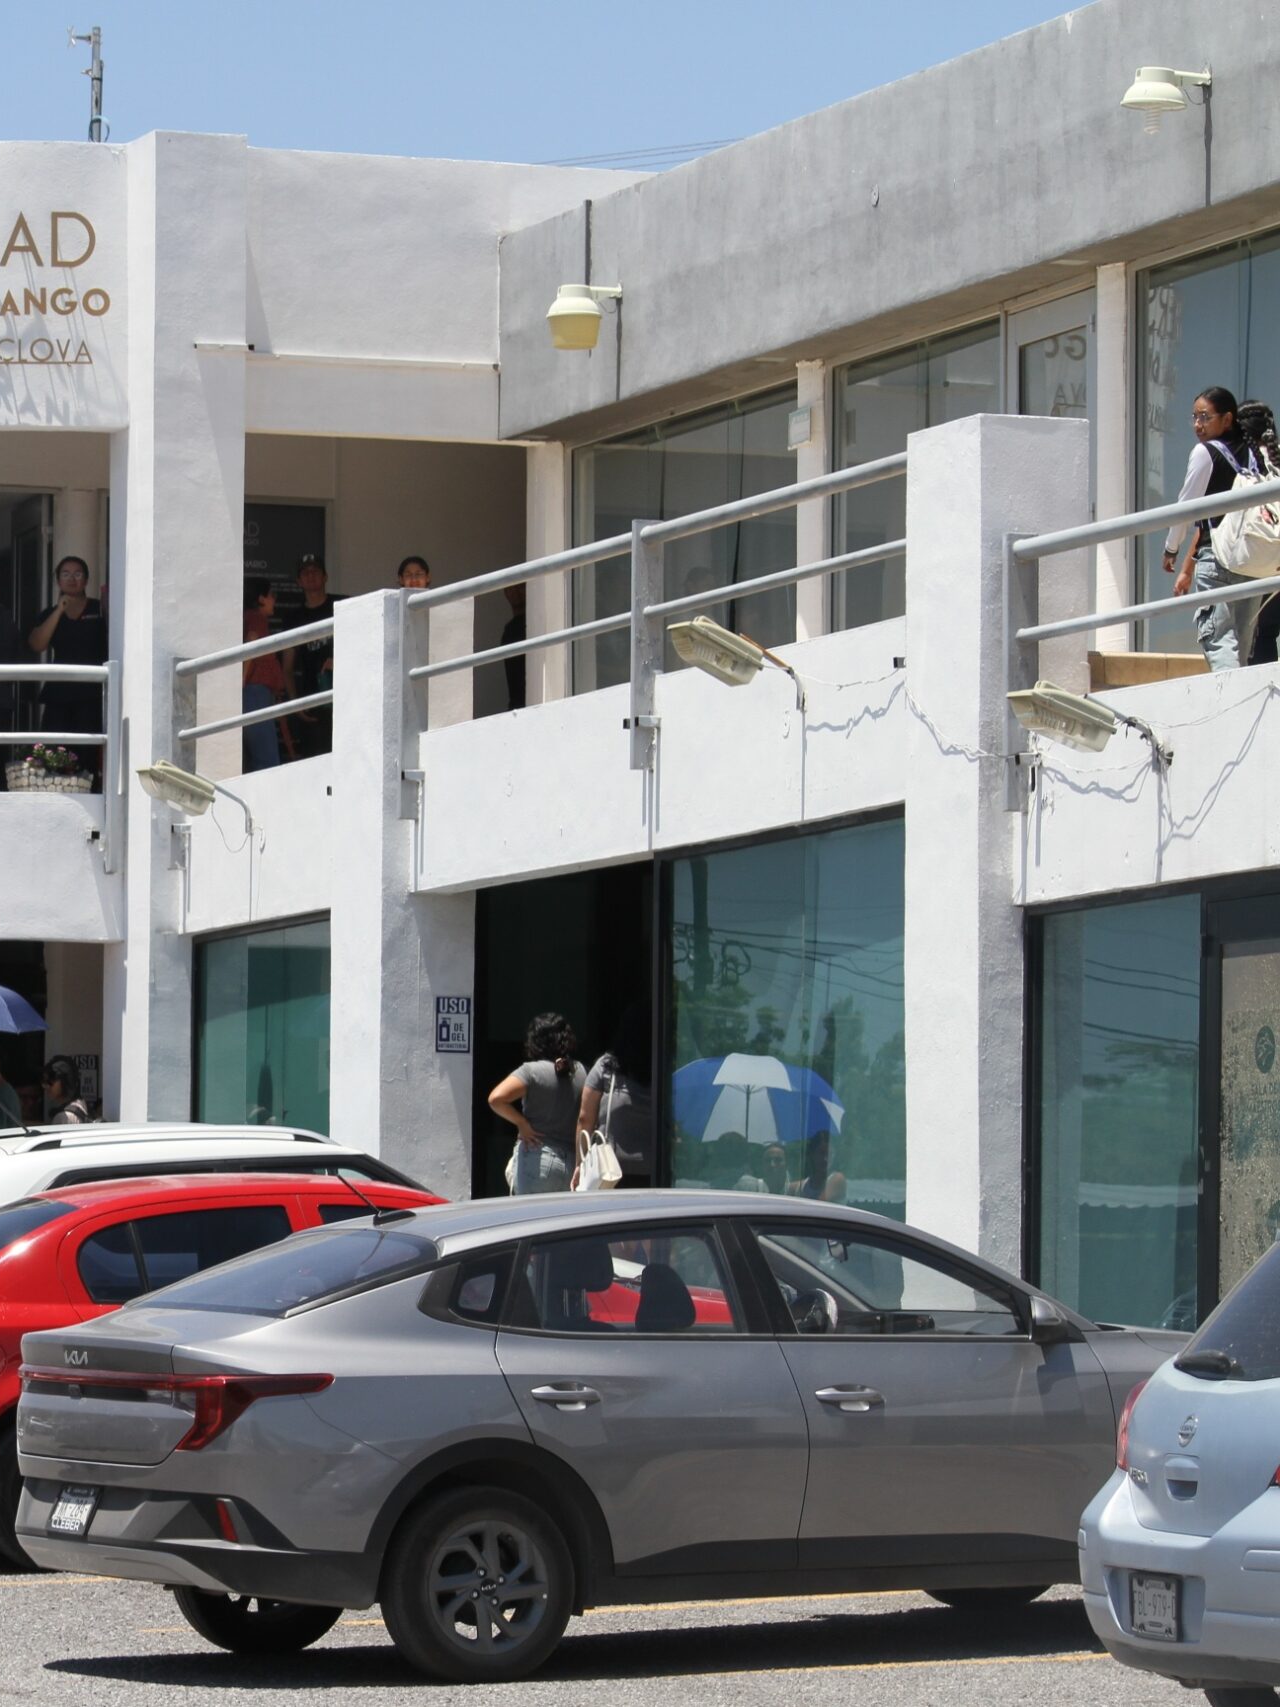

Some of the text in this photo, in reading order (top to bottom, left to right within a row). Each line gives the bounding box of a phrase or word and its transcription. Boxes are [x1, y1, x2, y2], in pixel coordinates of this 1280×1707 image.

[439, 998, 467, 1013] USO
[454, 1023, 464, 1032] DE
[451, 1033, 466, 1042] GEL
[64, 1350, 88, 1365] KIA
